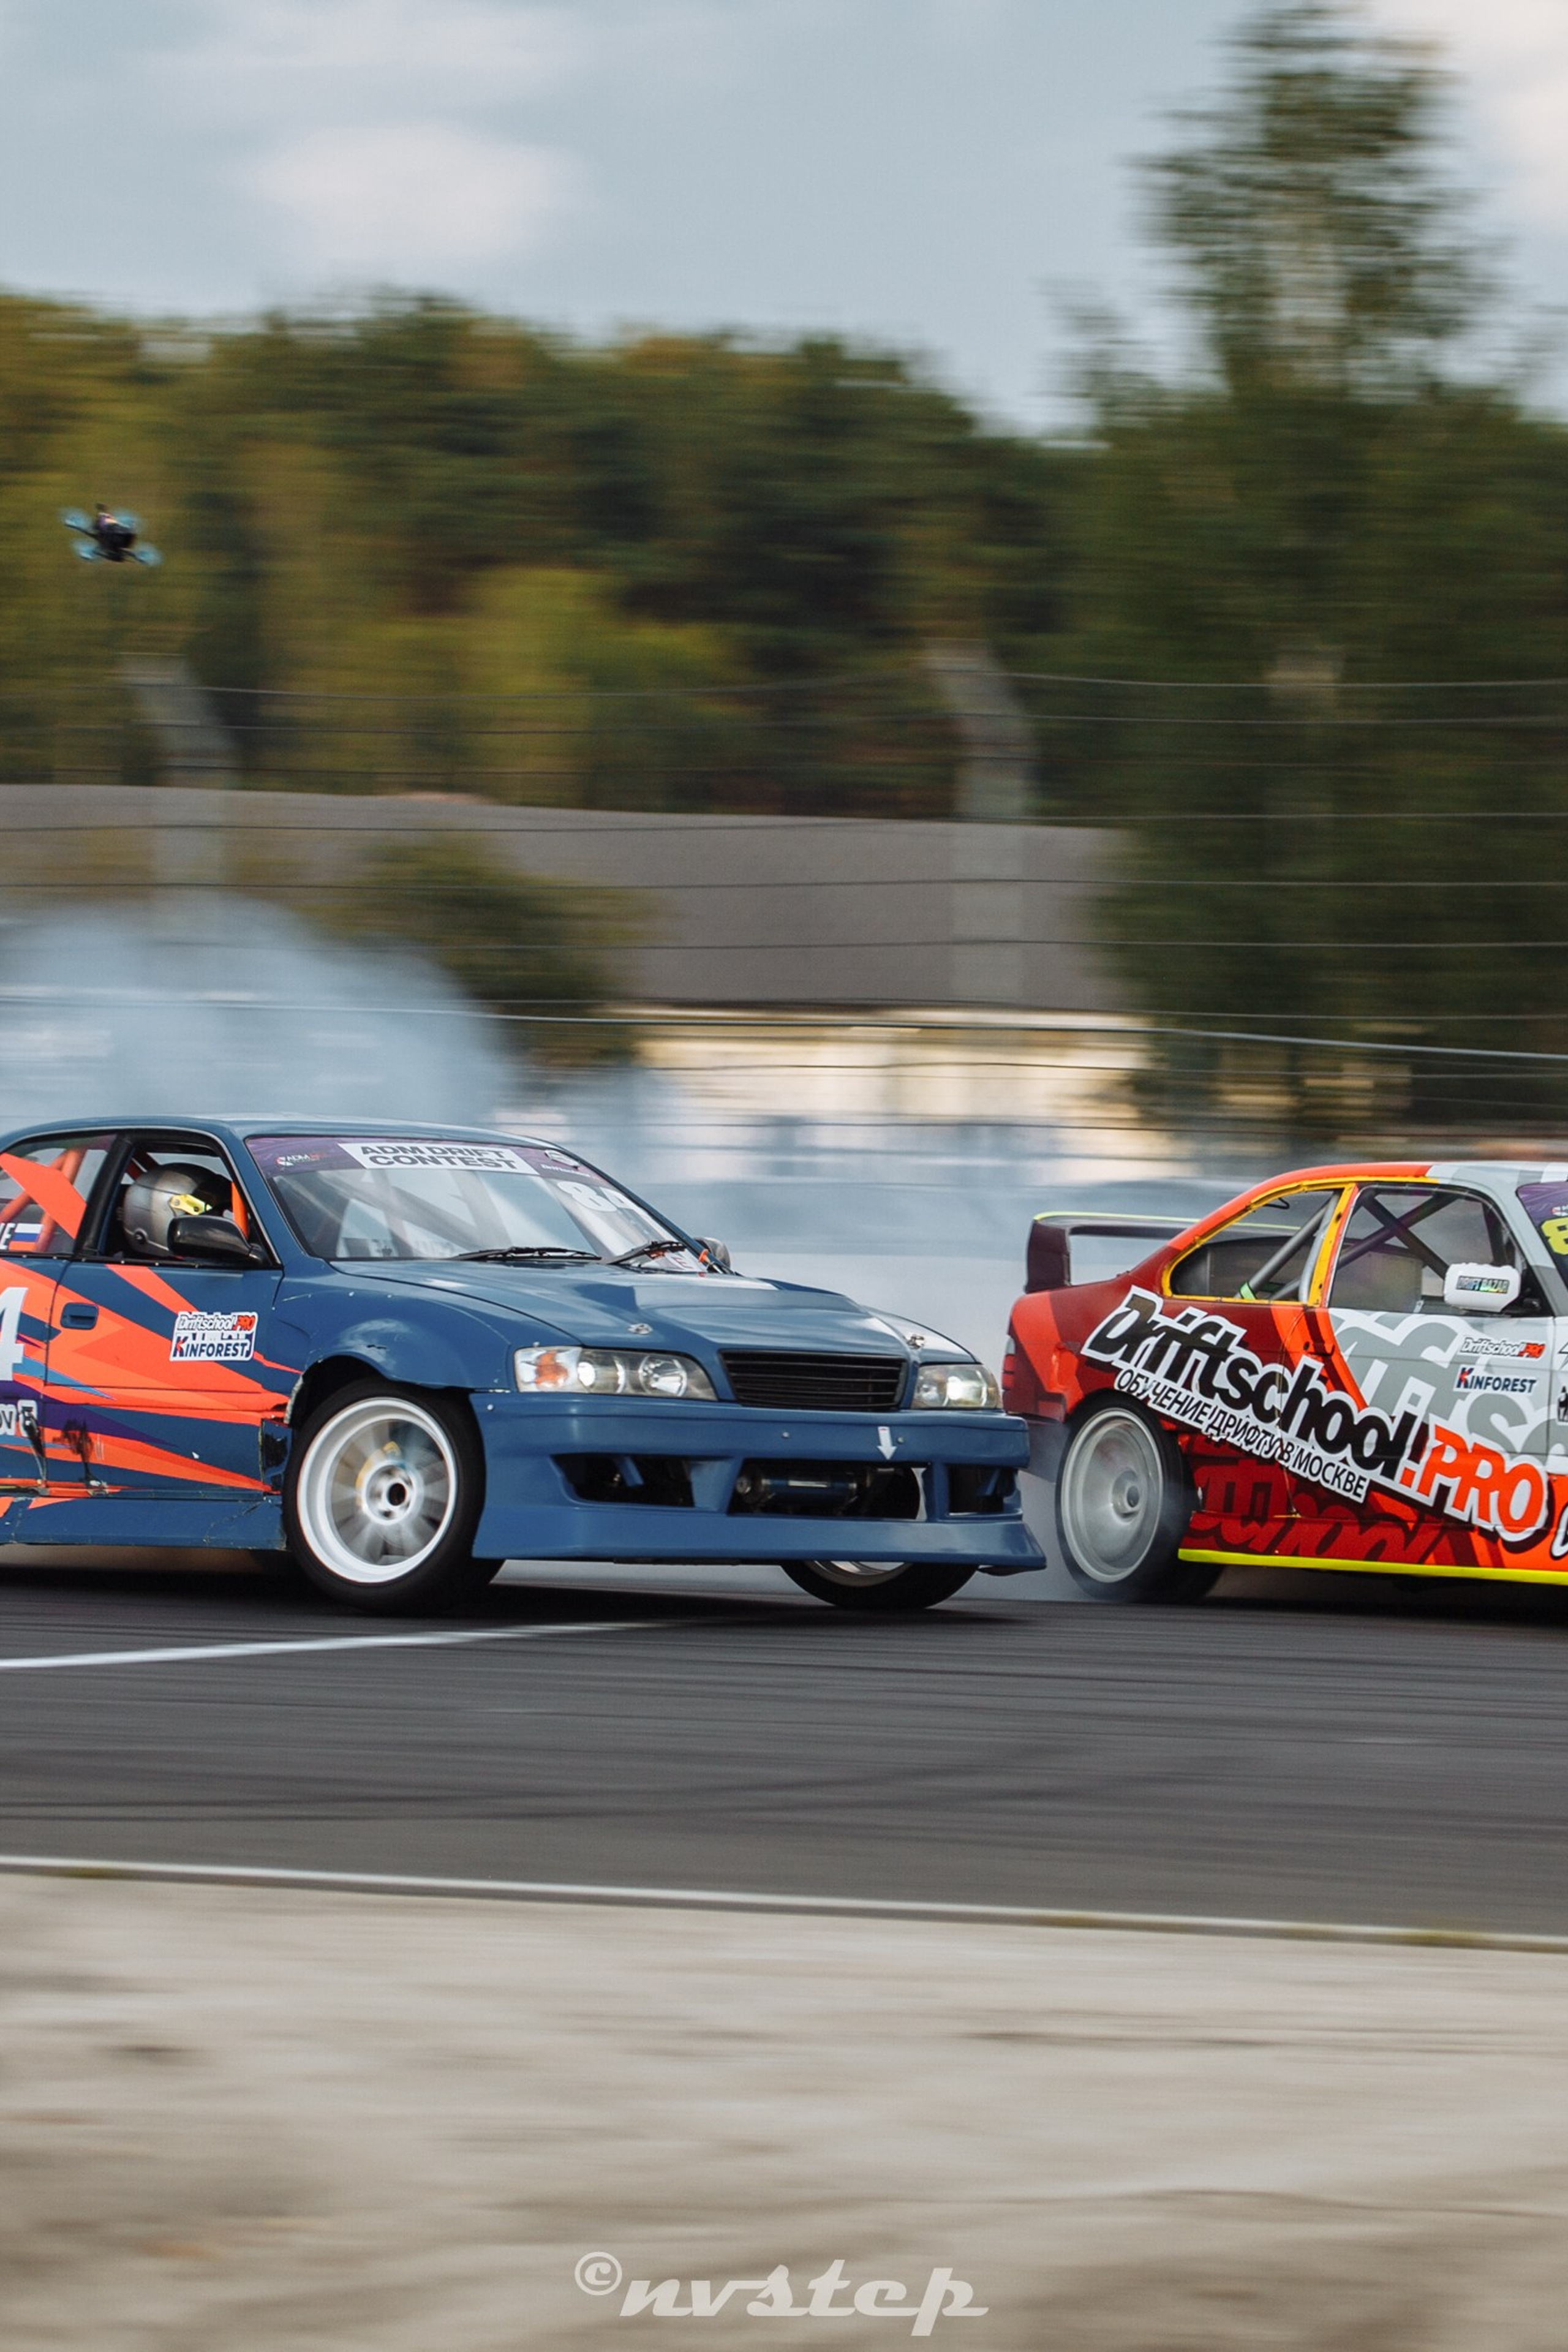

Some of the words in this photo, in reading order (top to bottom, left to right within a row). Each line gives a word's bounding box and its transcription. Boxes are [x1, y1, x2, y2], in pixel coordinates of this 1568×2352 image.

[360, 1145, 421, 1155] ADM
[430, 1147, 505, 1159] DRIFT
[369, 1155, 517, 1169] CONTEST
[173, 1336, 247, 1357] KINFOREST
[1457, 1367, 1537, 1393] KINFOREST
[1117, 1369, 1210, 1425] ОБУЧЕНИЕ
[1292, 1447, 1367, 1499] МОСКВЕ
